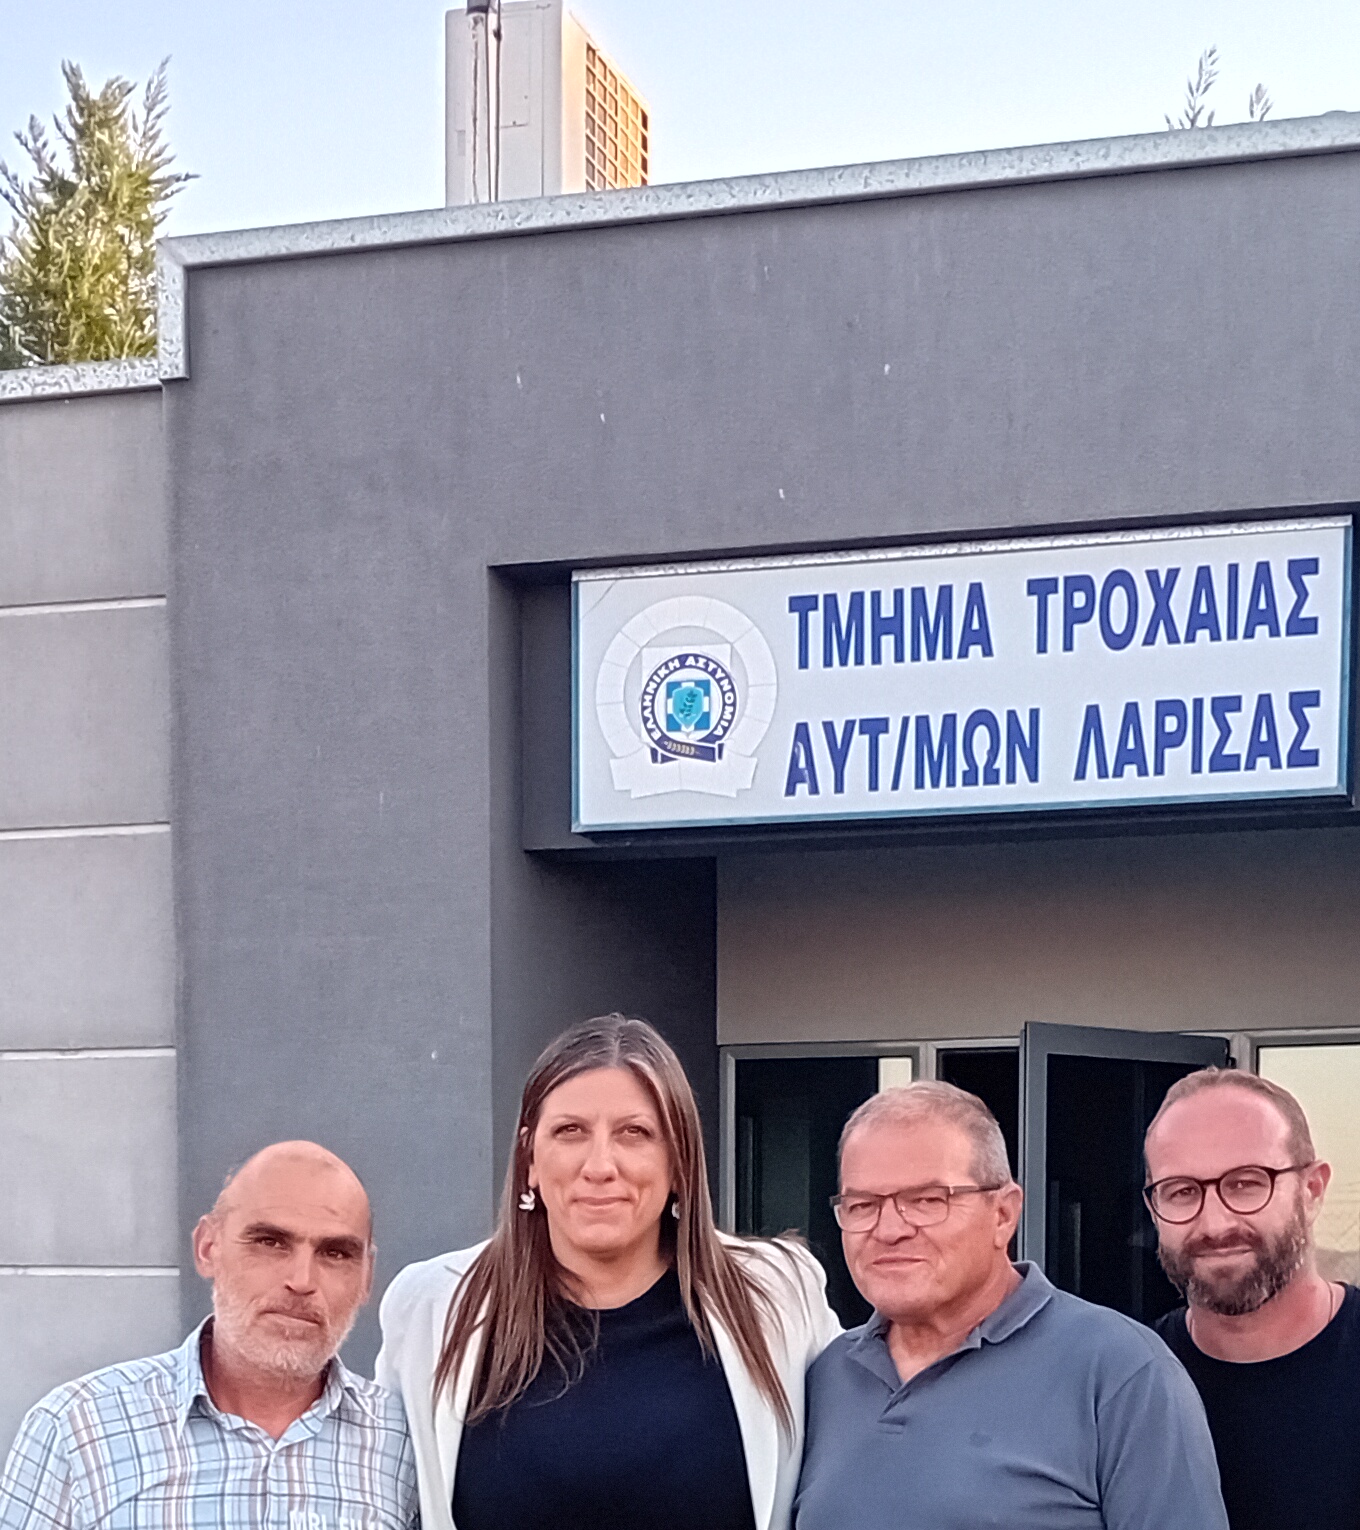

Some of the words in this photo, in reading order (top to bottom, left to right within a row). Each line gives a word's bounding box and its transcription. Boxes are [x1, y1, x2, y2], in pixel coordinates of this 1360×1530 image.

[788, 581, 995, 670] ΤΜΗΜΑ
[1026, 556, 1320, 655] ΤΡΟΧΑΙΑΣ
[642, 658, 681, 741] ΕΛΛΗΝΙΚΗ
[684, 655, 735, 737] ΑΣΤΥΝΟΜΙΑ
[783, 707, 1041, 798] ΑΥΤ/ΜΩΝ
[1073, 689, 1321, 782] ΛΑΡΙΣΑΣ
